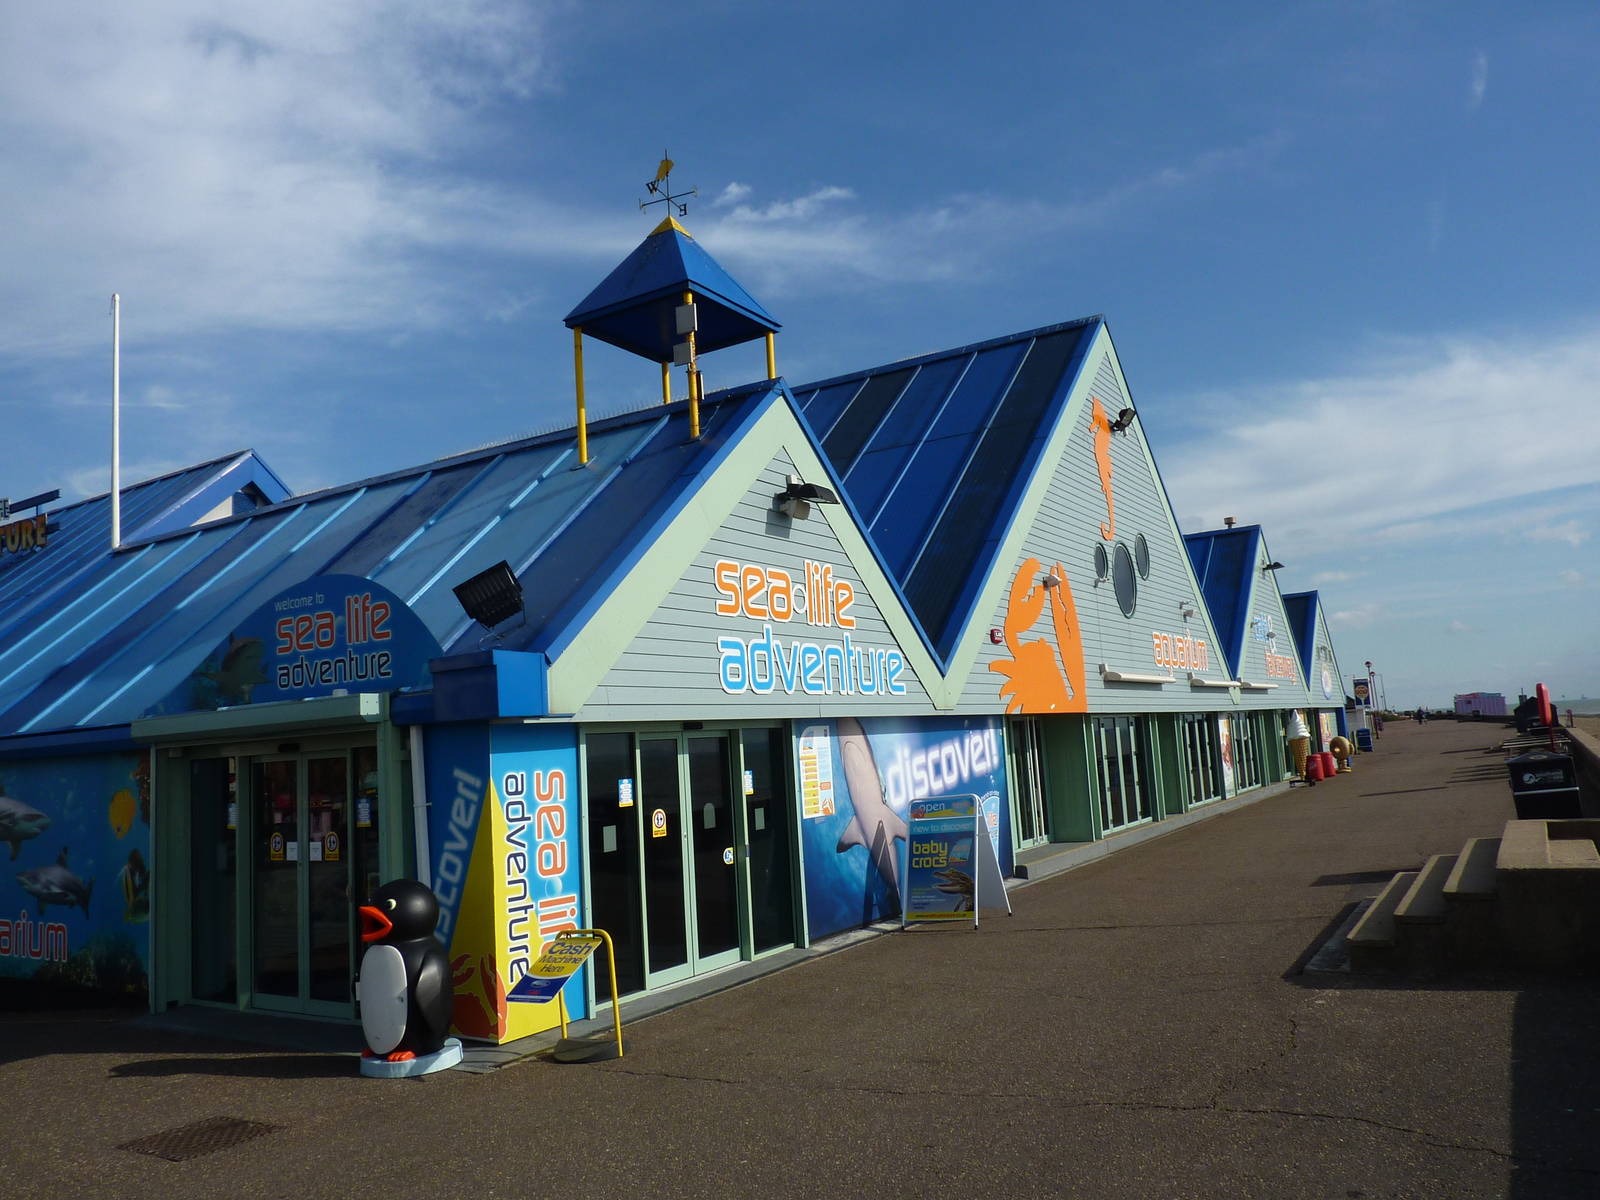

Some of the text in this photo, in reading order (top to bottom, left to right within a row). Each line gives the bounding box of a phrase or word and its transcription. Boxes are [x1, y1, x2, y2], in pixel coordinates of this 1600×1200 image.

[274, 592, 325, 612] welcome to
[714, 559, 857, 630] sea life
[276, 592, 391, 655] sea life
[277, 649, 391, 690] adventure
[717, 624, 907, 696] adventure
[1152, 629, 1208, 676] aquarium
[887, 723, 999, 807] discover!
[535, 770, 567, 878] sea
[920, 802, 945, 814] open
[912, 840, 948, 858] baby
[912, 856, 948, 869] crocs
[504, 772, 533, 985] adventure
[539, 955, 583, 965] Machine
[540, 964, 565, 973] Here
[548, 941, 593, 955] Cash
